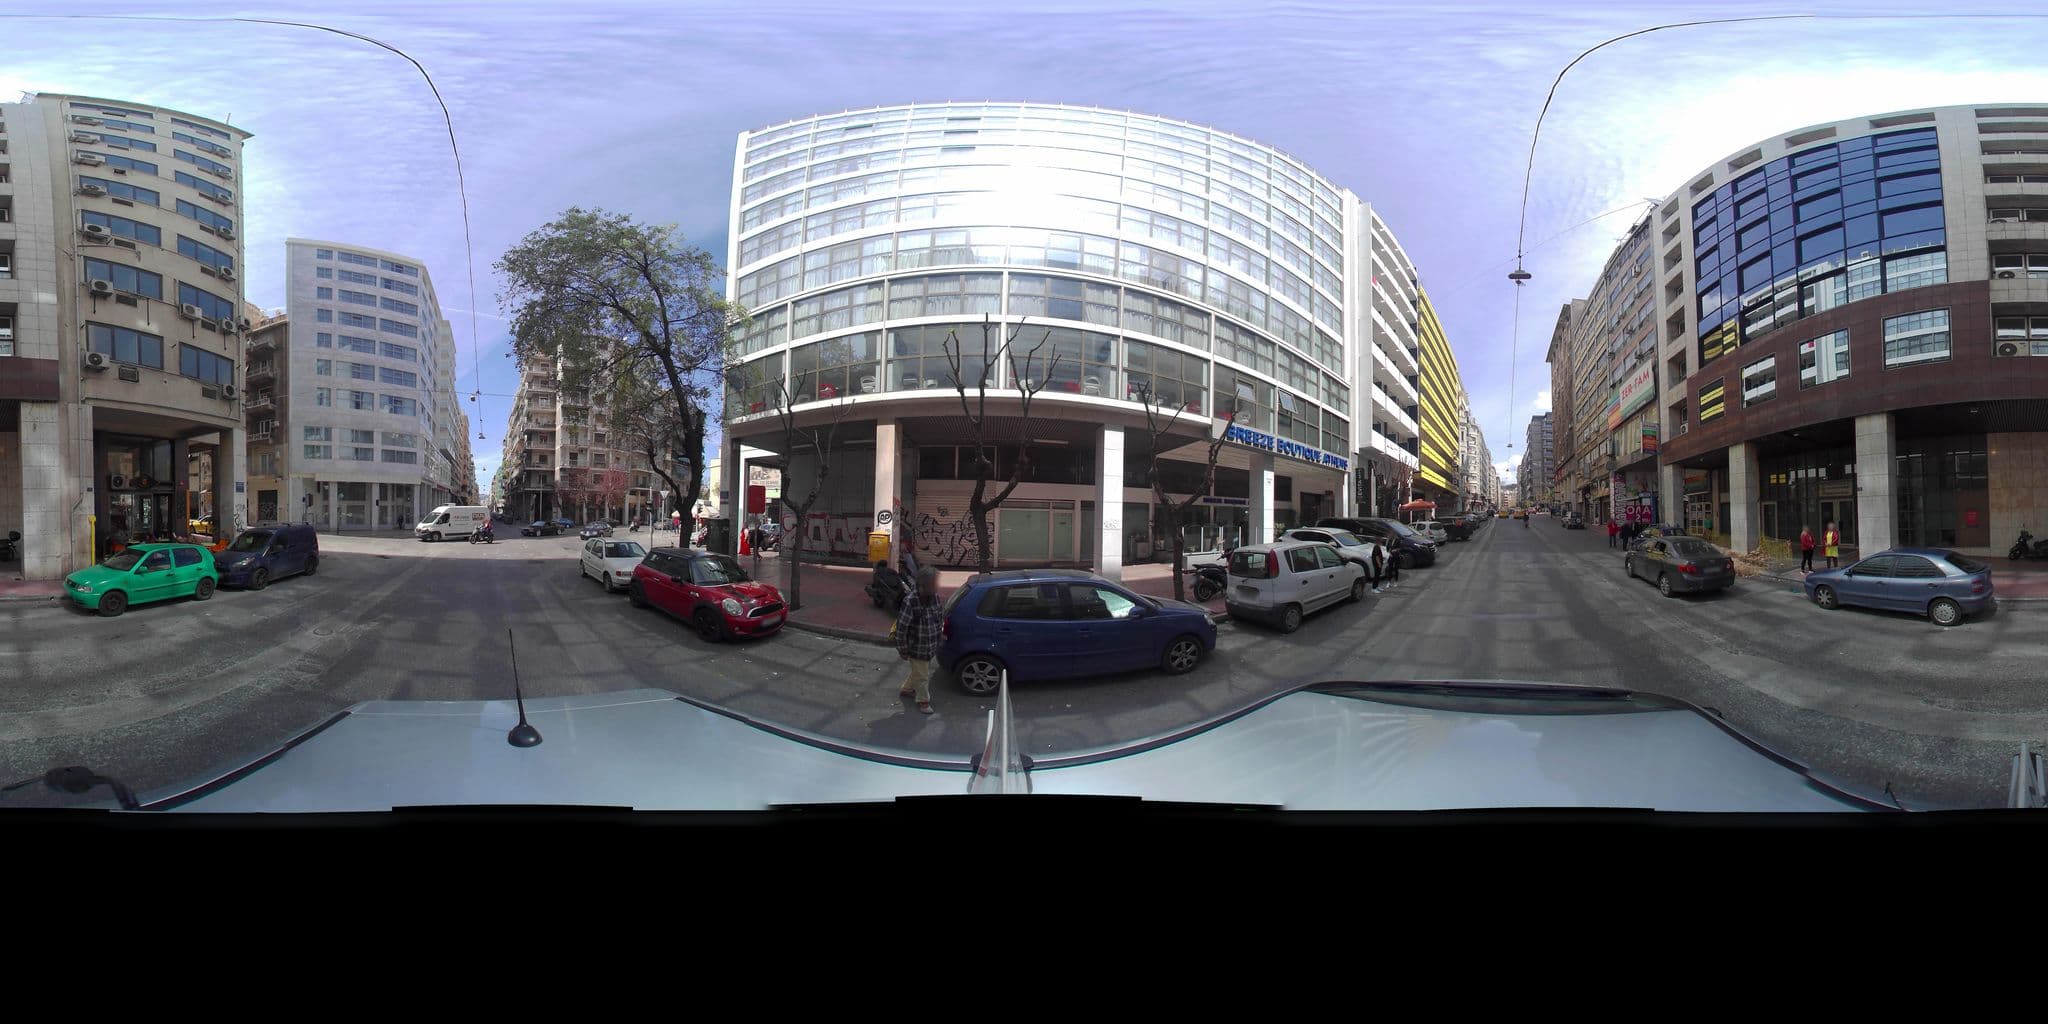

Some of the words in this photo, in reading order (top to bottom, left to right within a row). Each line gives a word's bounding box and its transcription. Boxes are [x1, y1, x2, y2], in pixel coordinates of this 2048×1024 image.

[1226, 424, 1275, 450] BREEZE
[1277, 438, 1321, 462] BOUTIQUE
[1322, 453, 1348, 471] ATHENS
